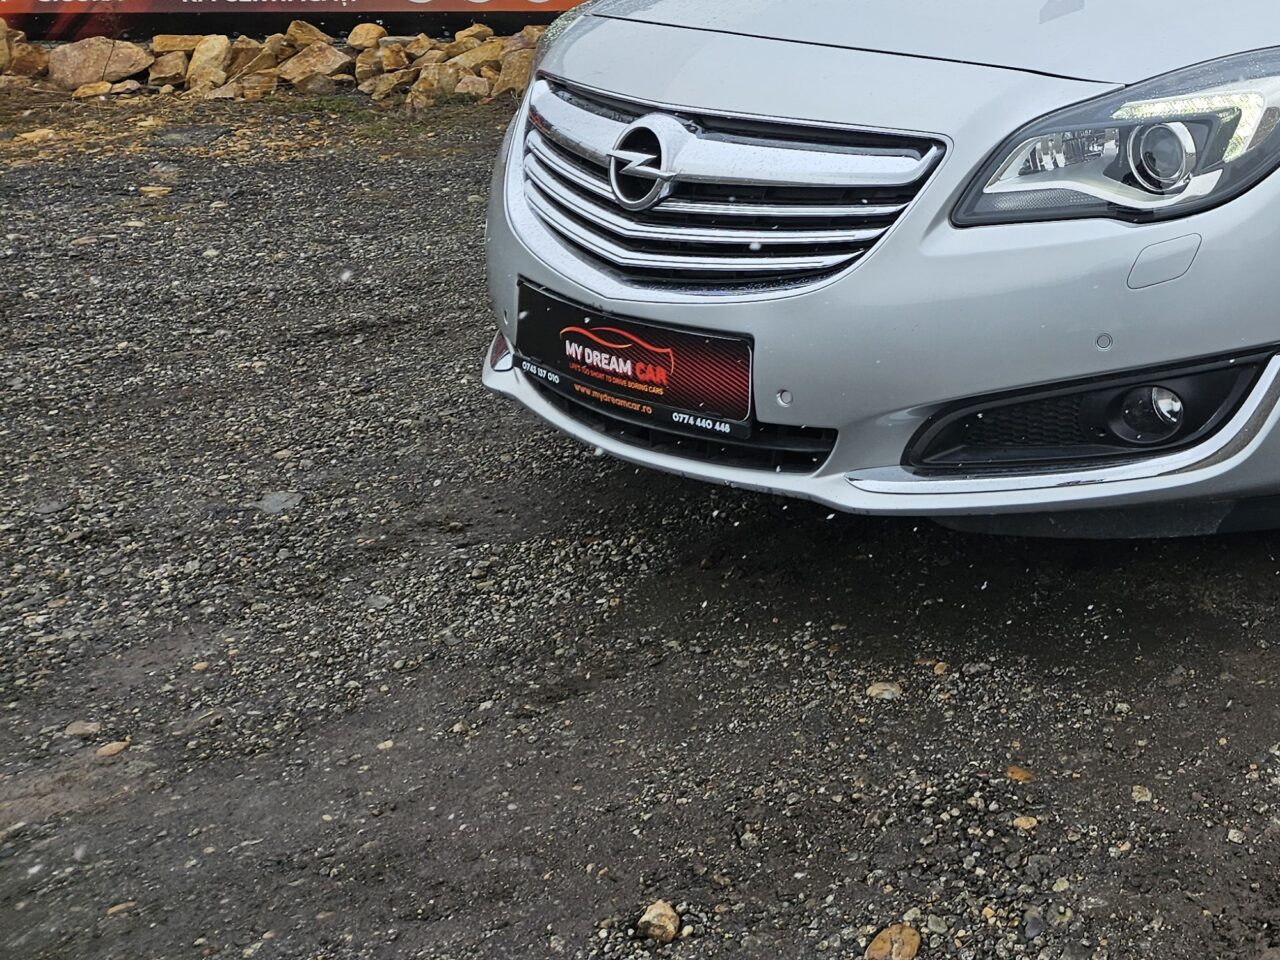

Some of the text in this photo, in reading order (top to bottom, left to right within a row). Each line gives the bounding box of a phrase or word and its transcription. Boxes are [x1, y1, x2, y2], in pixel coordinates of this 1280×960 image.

[565, 339, 670, 385] MY DREAM CAR
[672, 412, 731, 433] 0774 440 448
